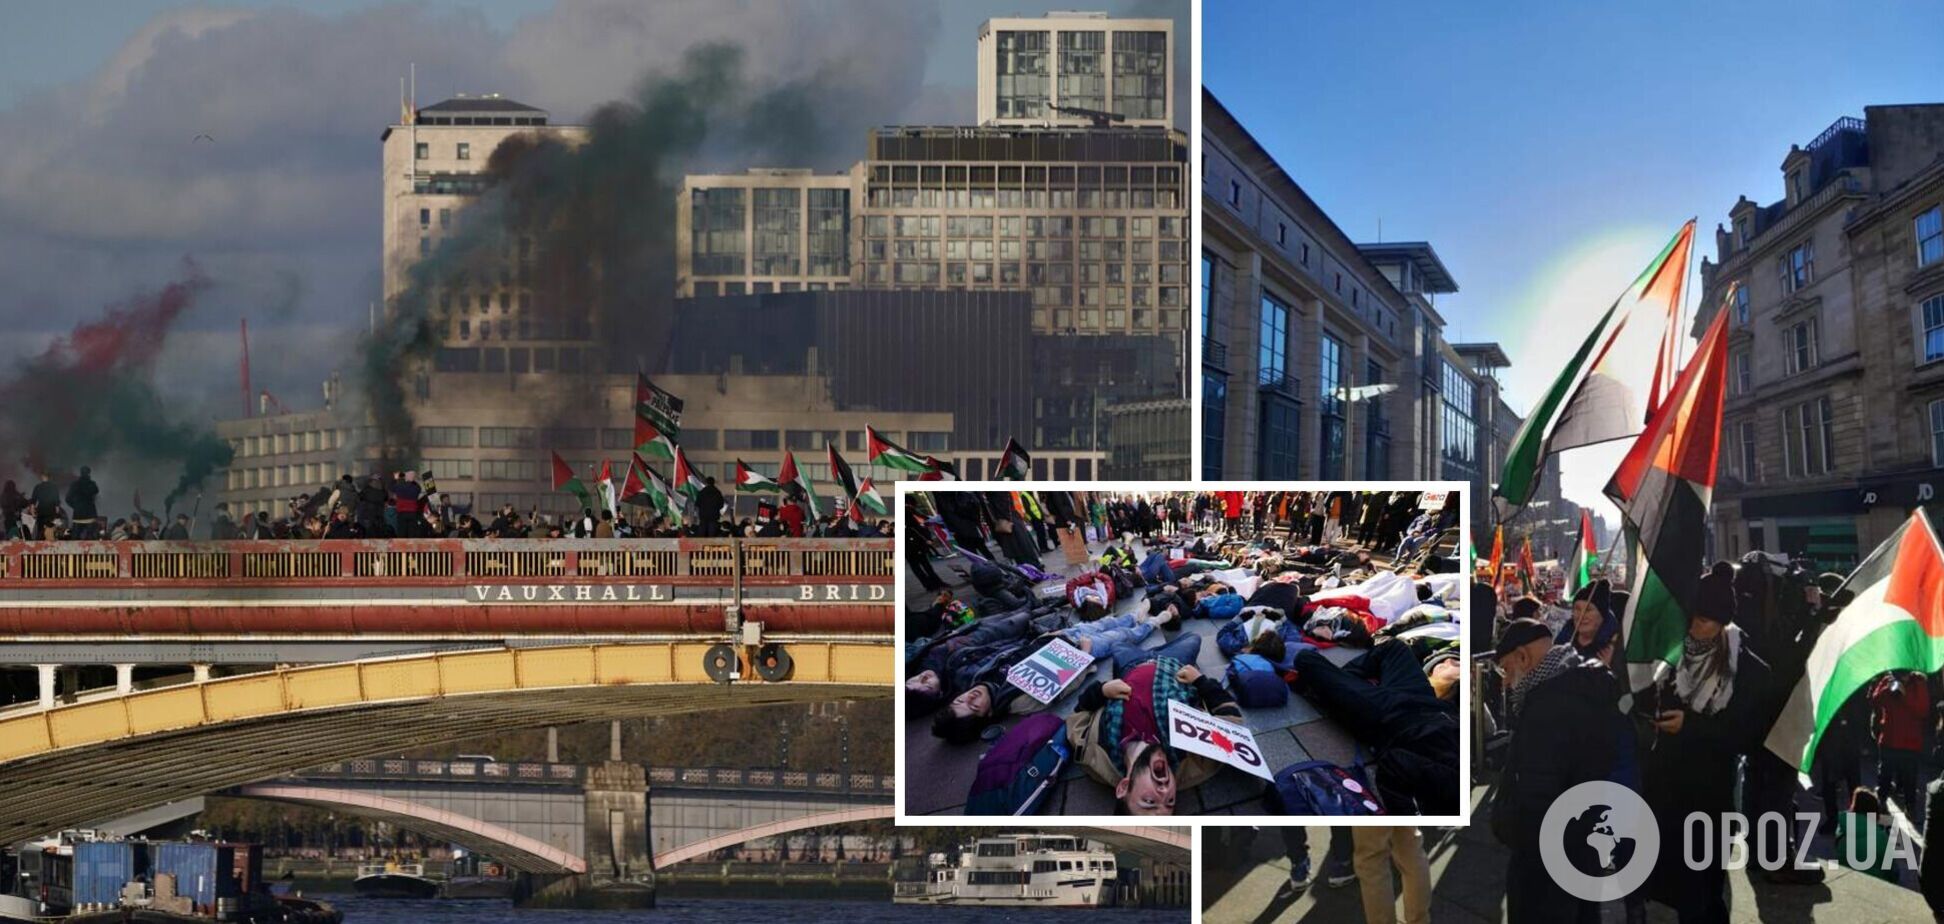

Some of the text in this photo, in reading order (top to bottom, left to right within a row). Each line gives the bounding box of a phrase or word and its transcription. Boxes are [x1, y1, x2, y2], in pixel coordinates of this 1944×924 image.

[1423, 492, 1446, 501] Gza
[1863, 492, 1878, 504] JD
[1917, 483, 1934, 500] JD
[474, 584, 885, 600] VAUXHALL BRID
[1011, 664, 1062, 697] NOW!
[1175, 717, 1262, 767] Gza
